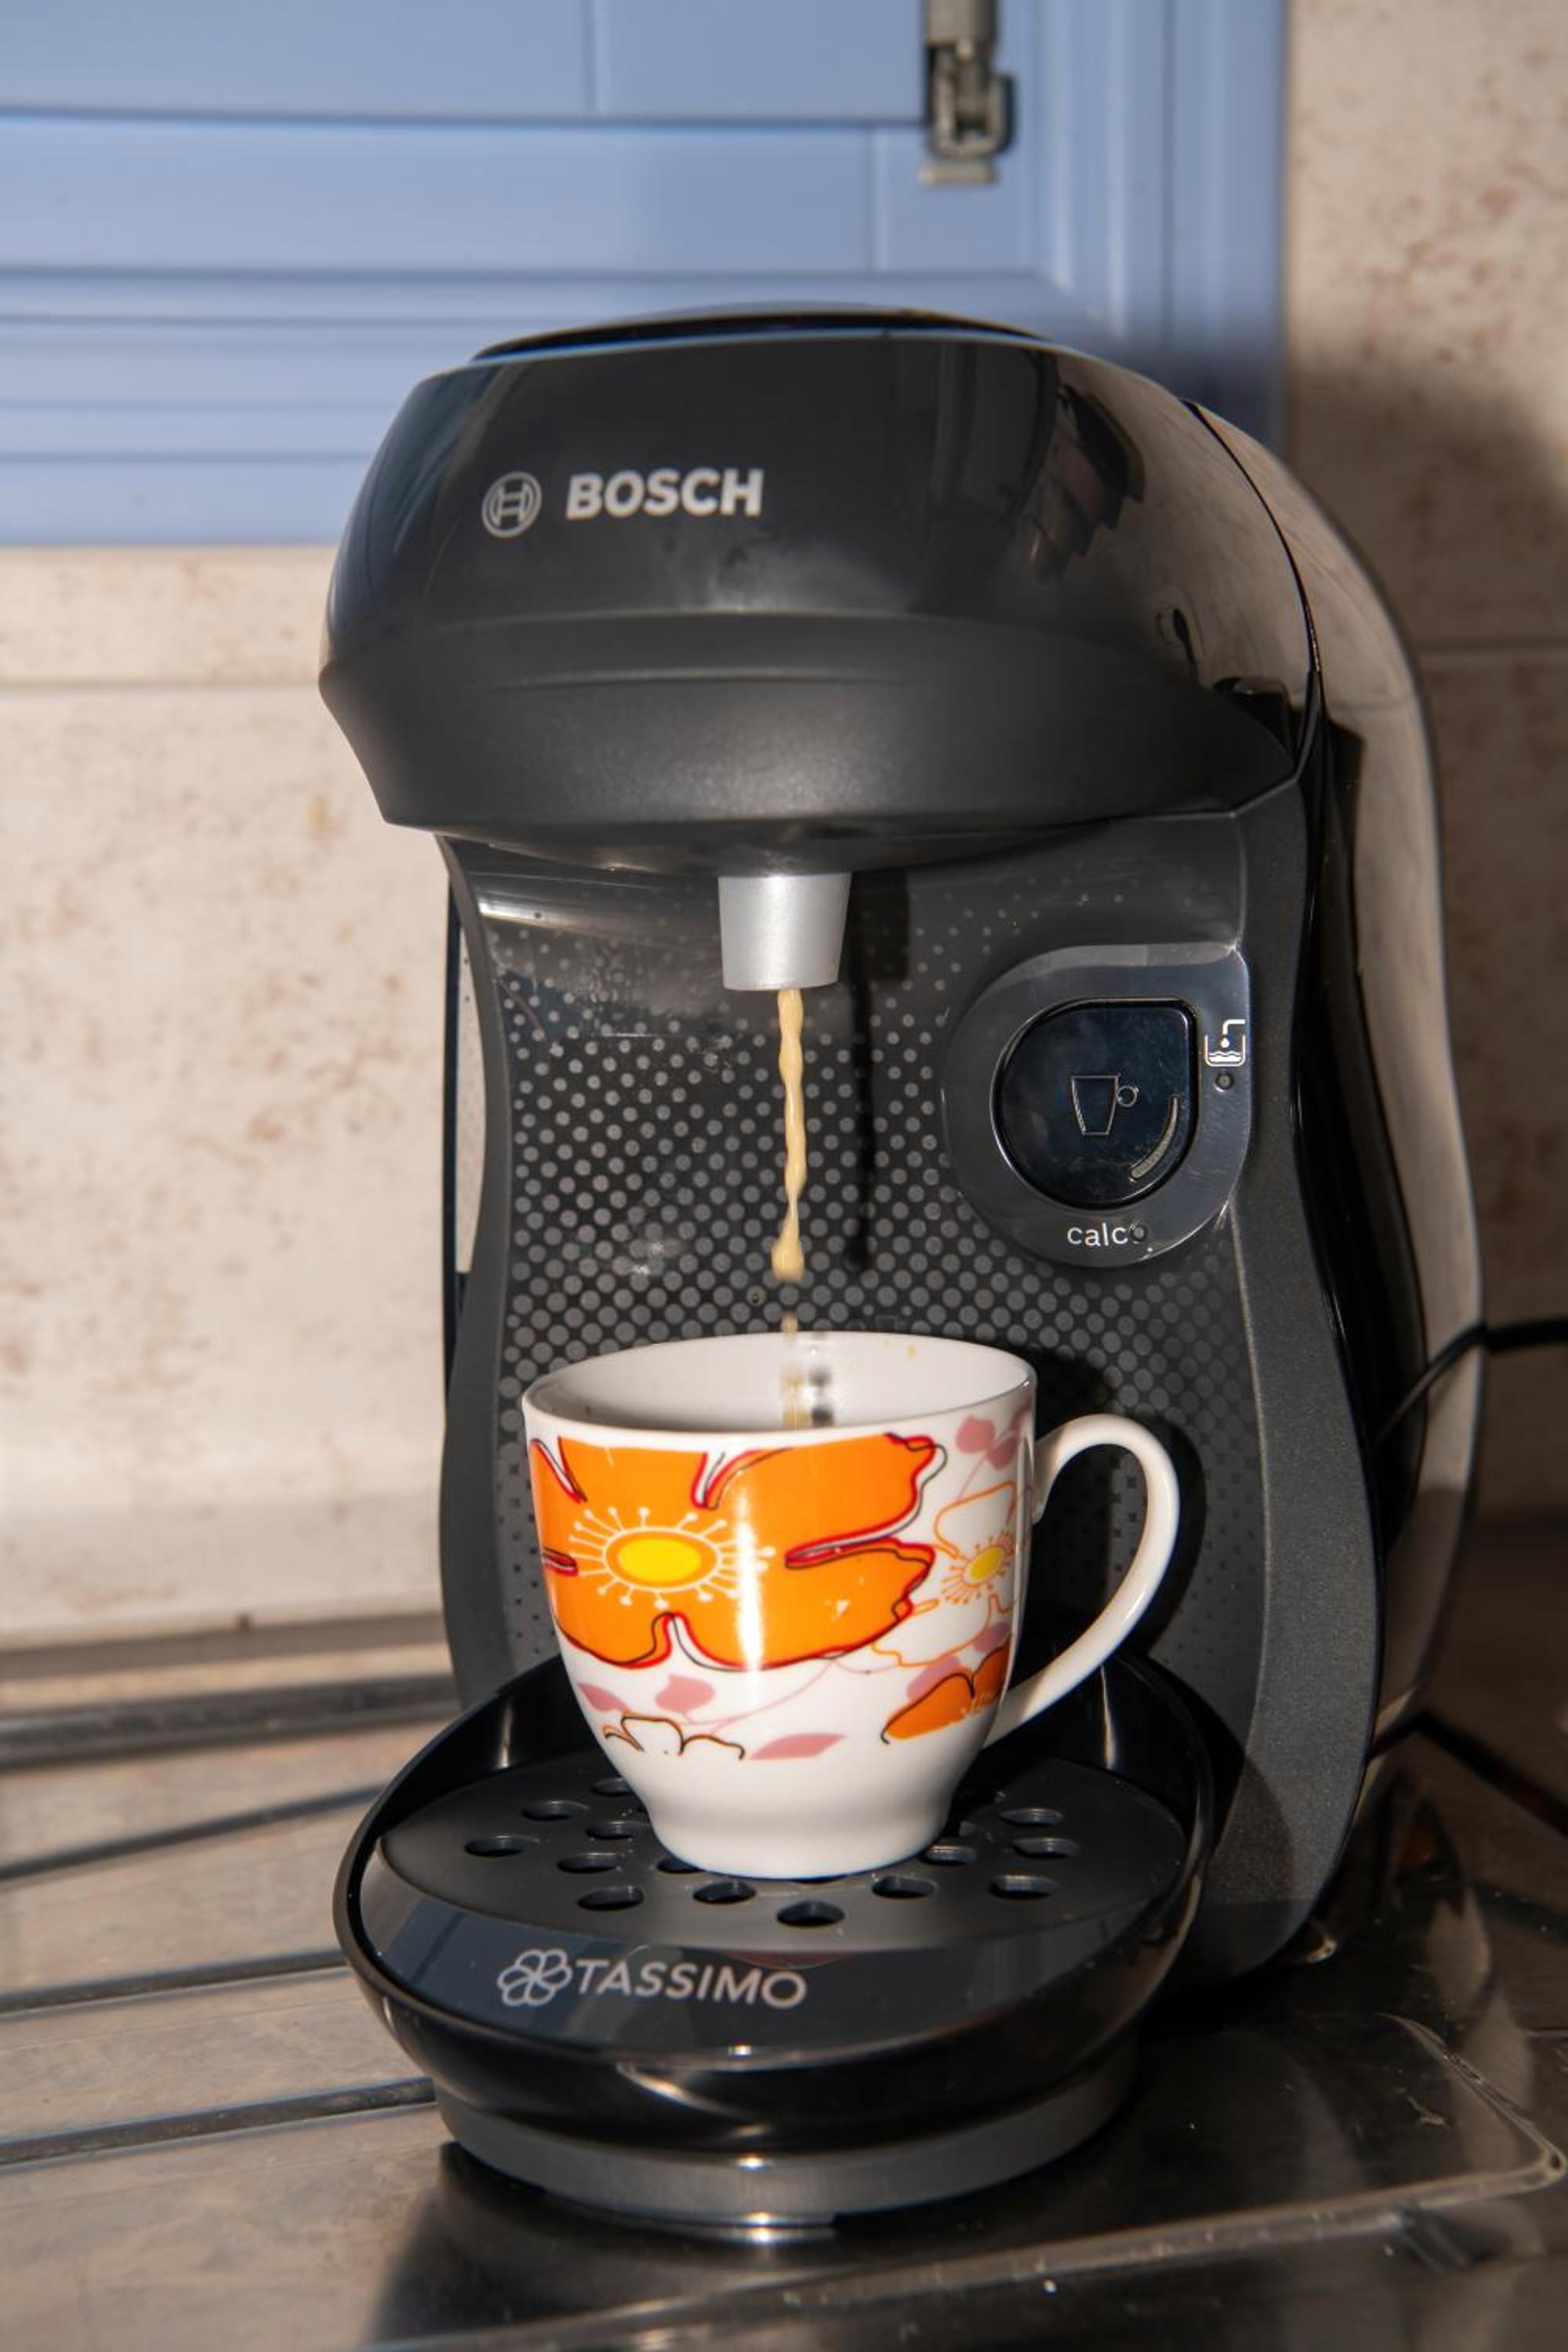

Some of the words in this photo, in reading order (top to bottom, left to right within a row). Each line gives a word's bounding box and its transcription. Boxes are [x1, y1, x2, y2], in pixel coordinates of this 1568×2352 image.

[565, 467, 764, 520] BOSCH
[1067, 1222, 1128, 1247] calc
[575, 1958, 807, 2009] TASSIMO
